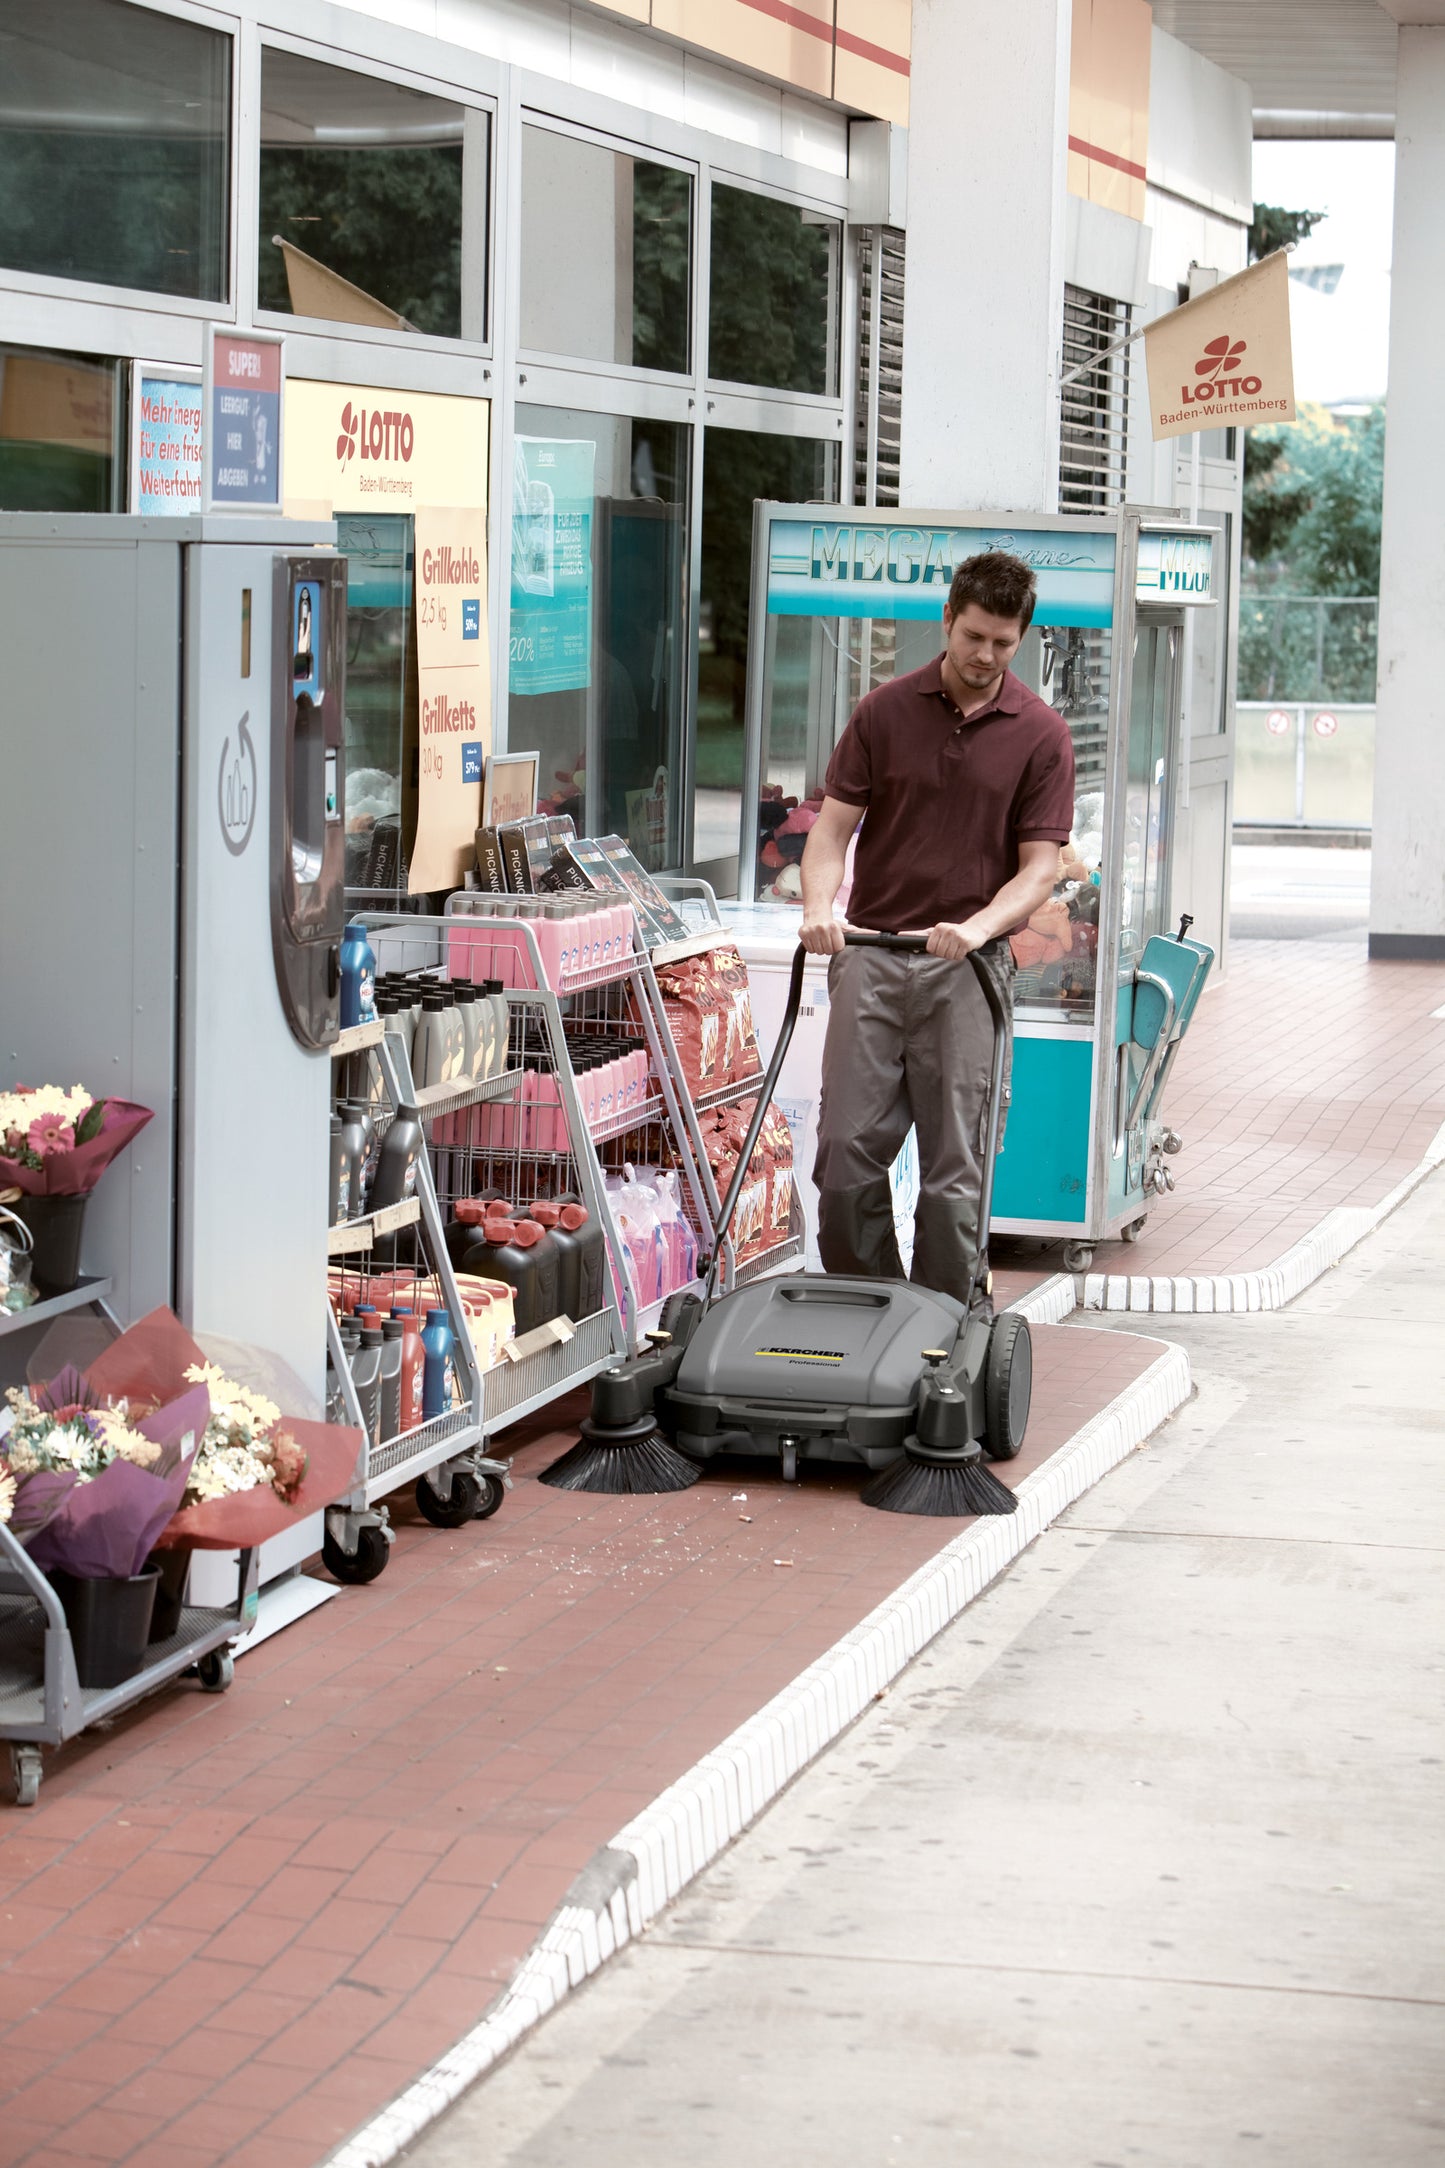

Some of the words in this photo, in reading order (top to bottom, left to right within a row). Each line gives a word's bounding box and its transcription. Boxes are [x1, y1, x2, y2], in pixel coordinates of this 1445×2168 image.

[229, 350, 261, 379] SUPER!
[1181, 376, 1262, 405] LOTTO
[141, 396, 172, 425] Mehr
[174, 399, 202, 434] Energ
[220, 395, 250, 418] LEERGUT
[1160, 398, 1287, 426] Baden-Württemberg
[159, 433, 180, 461] eine
[227, 432, 243, 451] HIER
[361, 409, 414, 462] LOTTO
[217, 468, 249, 488] ABGEBEN
[360, 475, 413, 498] Baden-Württemberg
[422, 546, 480, 585] Grillkohle
[809, 525, 958, 586] MEGA
[421, 597, 435, 628] 2,5
[438, 595, 447, 631] kg
[510, 636, 534, 662] 20%
[422, 694, 476, 735] Grillketts
[433, 744, 443, 780] kg
[769, 1347, 845, 1358] KÄRCHER
[789, 1359, 841, 1368] Professional
